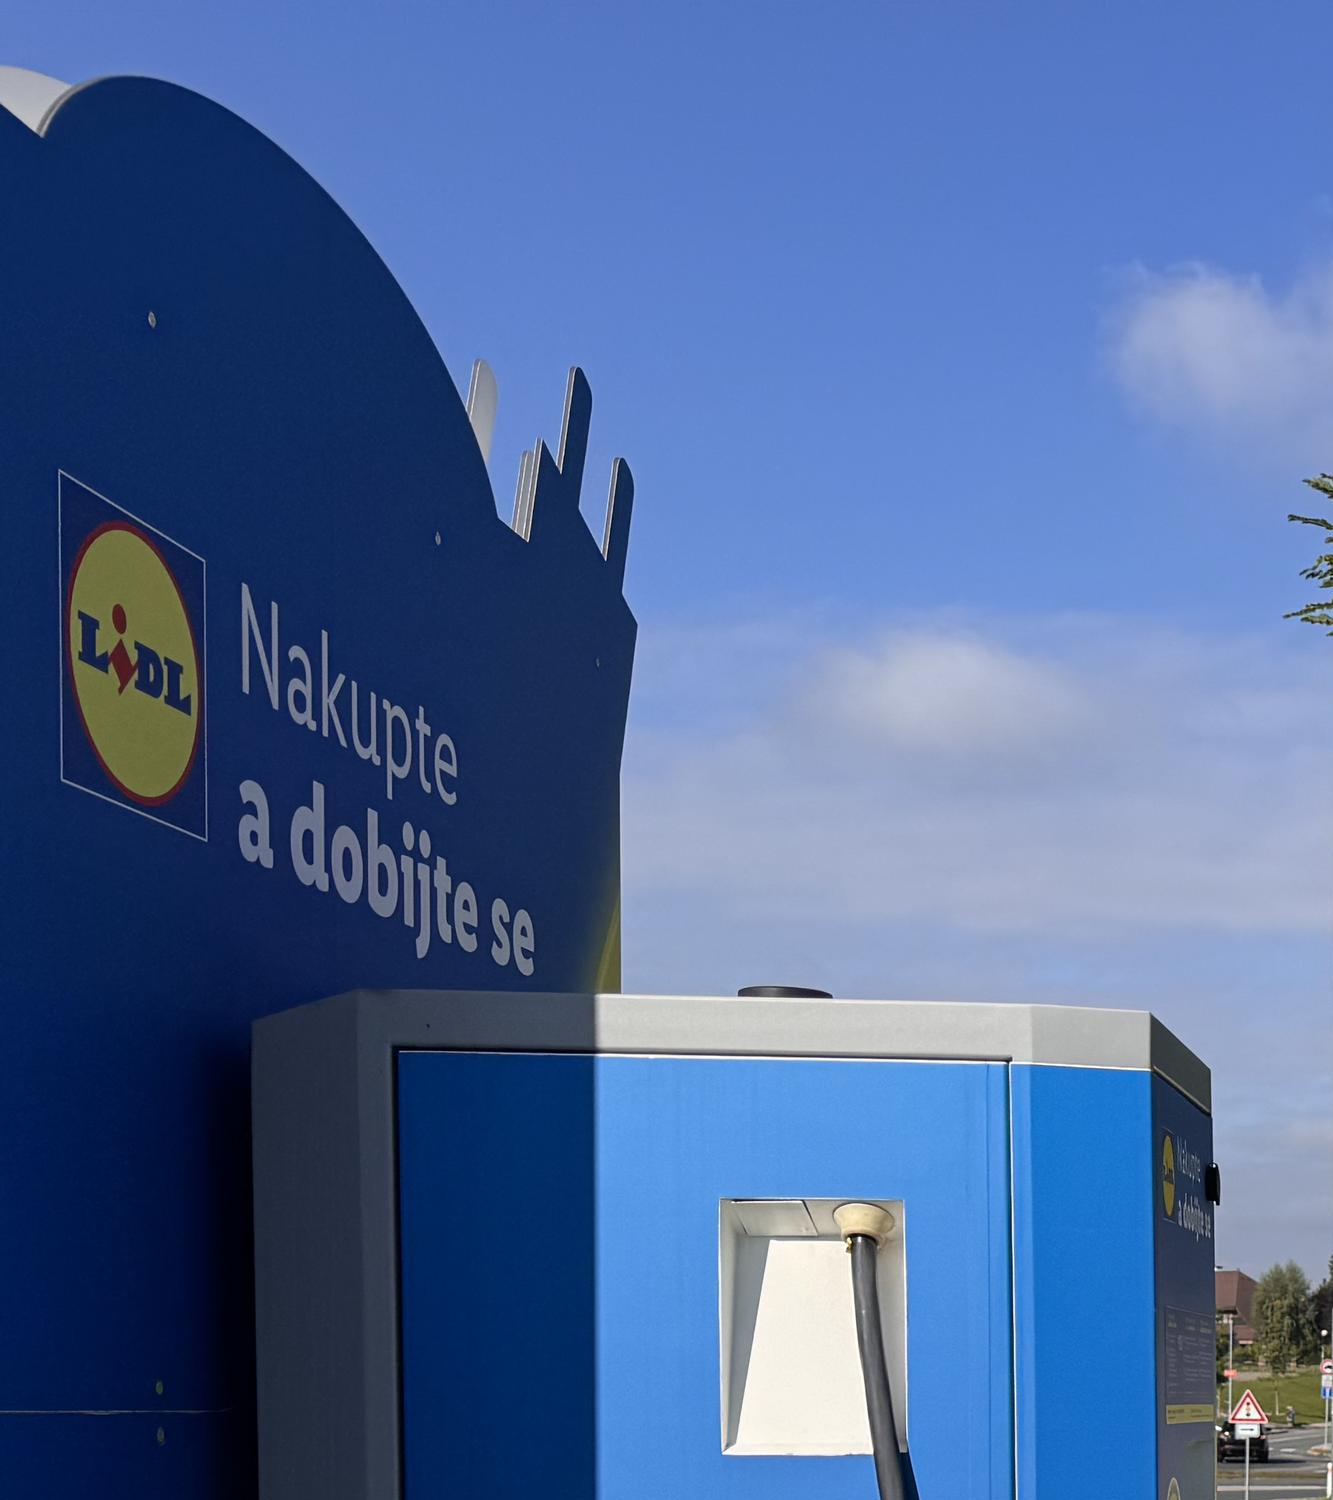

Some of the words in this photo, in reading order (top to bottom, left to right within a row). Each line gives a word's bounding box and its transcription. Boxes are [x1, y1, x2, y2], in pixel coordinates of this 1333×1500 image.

[241, 582, 458, 806] Nakupte
[238, 779, 274, 869] a
[290, 780, 478, 959] dobijte
[491, 898, 535, 977] se
